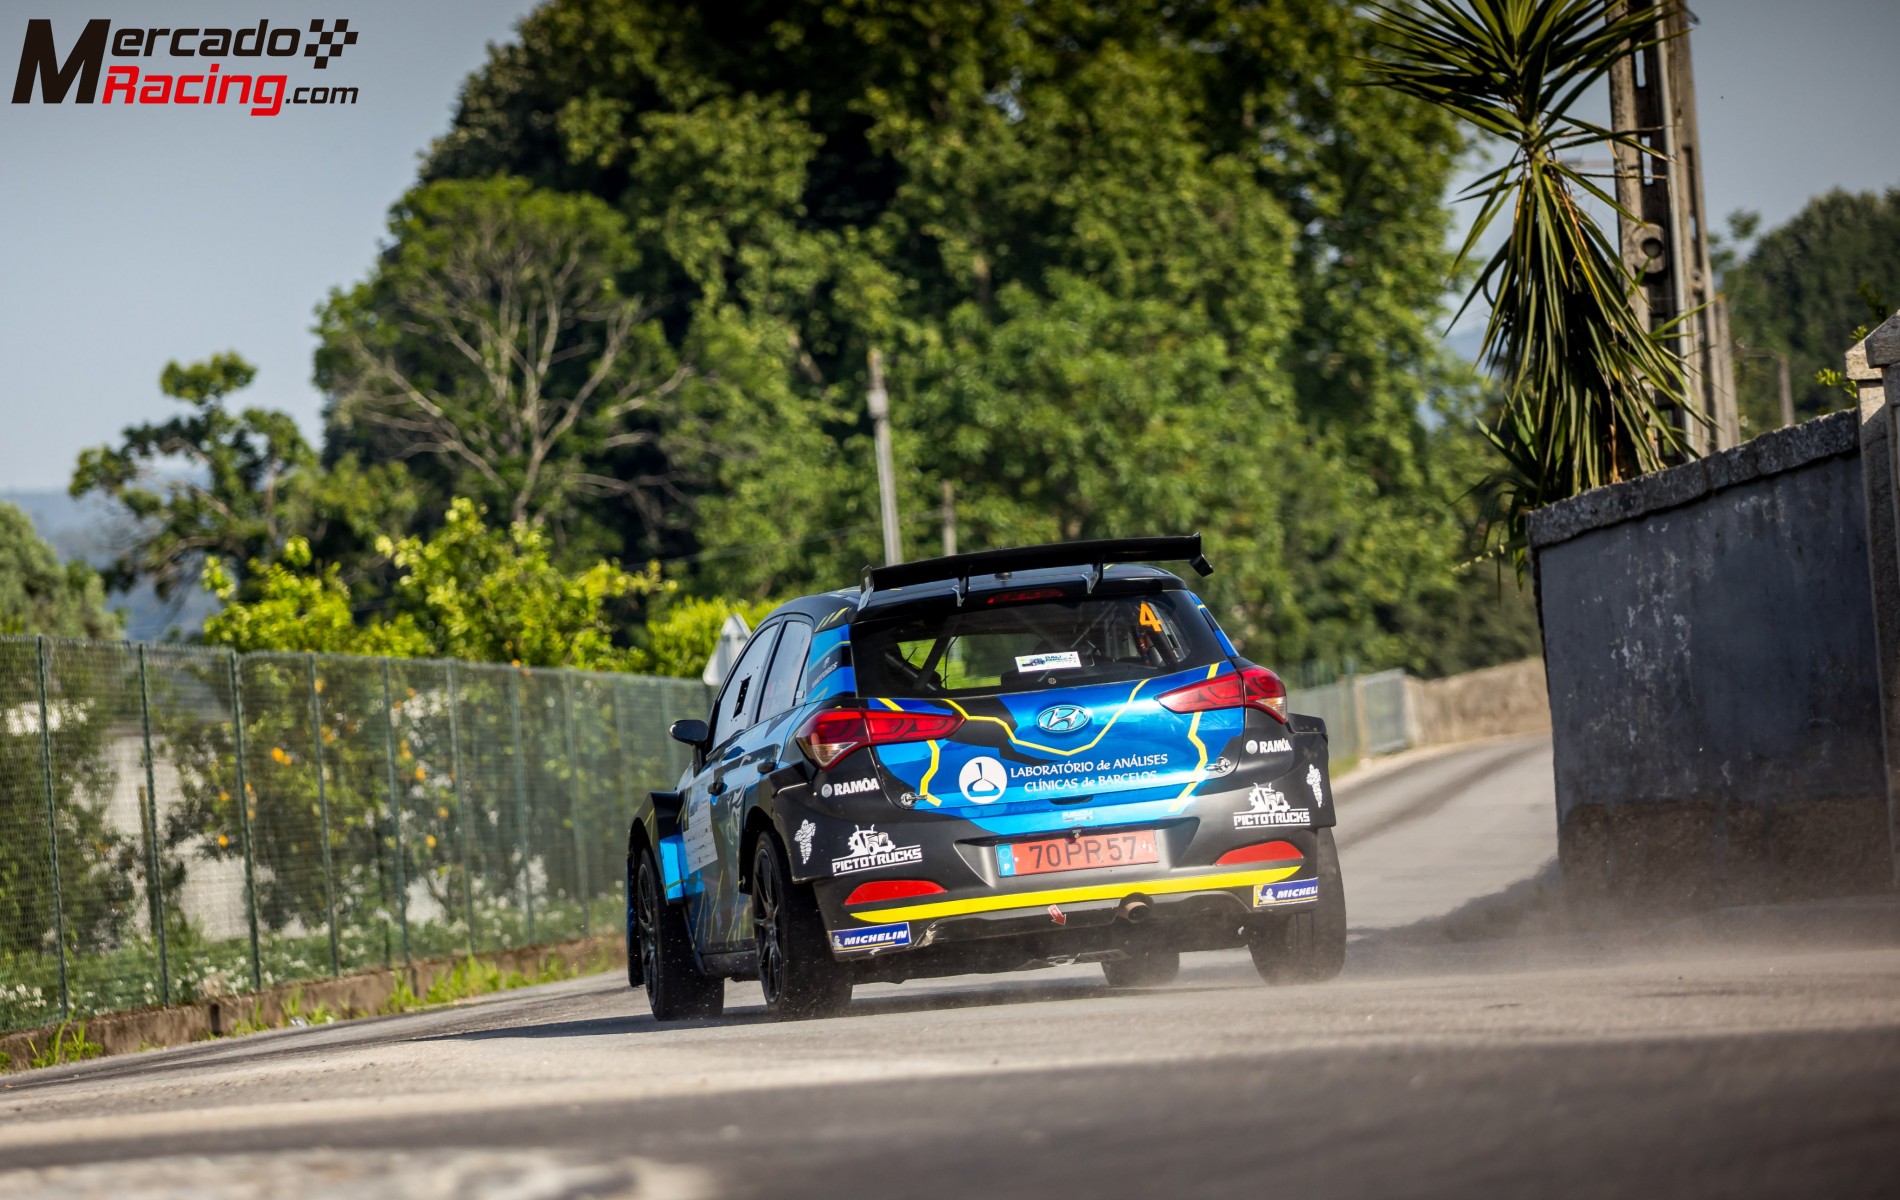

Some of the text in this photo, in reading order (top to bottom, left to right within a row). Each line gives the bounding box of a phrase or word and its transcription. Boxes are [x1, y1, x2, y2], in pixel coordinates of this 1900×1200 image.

[1139, 602, 1162, 632] 4
[1010, 753, 1168, 778] LABORATÓRIO de ANÁLISES
[1024, 770, 1158, 793] CLÍNICAS de BARCELOS
[1233, 811, 1311, 827] PICTOTRUCKS
[832, 847, 923, 874] PICTOTRUCKS
[844, 930, 908, 946] MICHELIN
